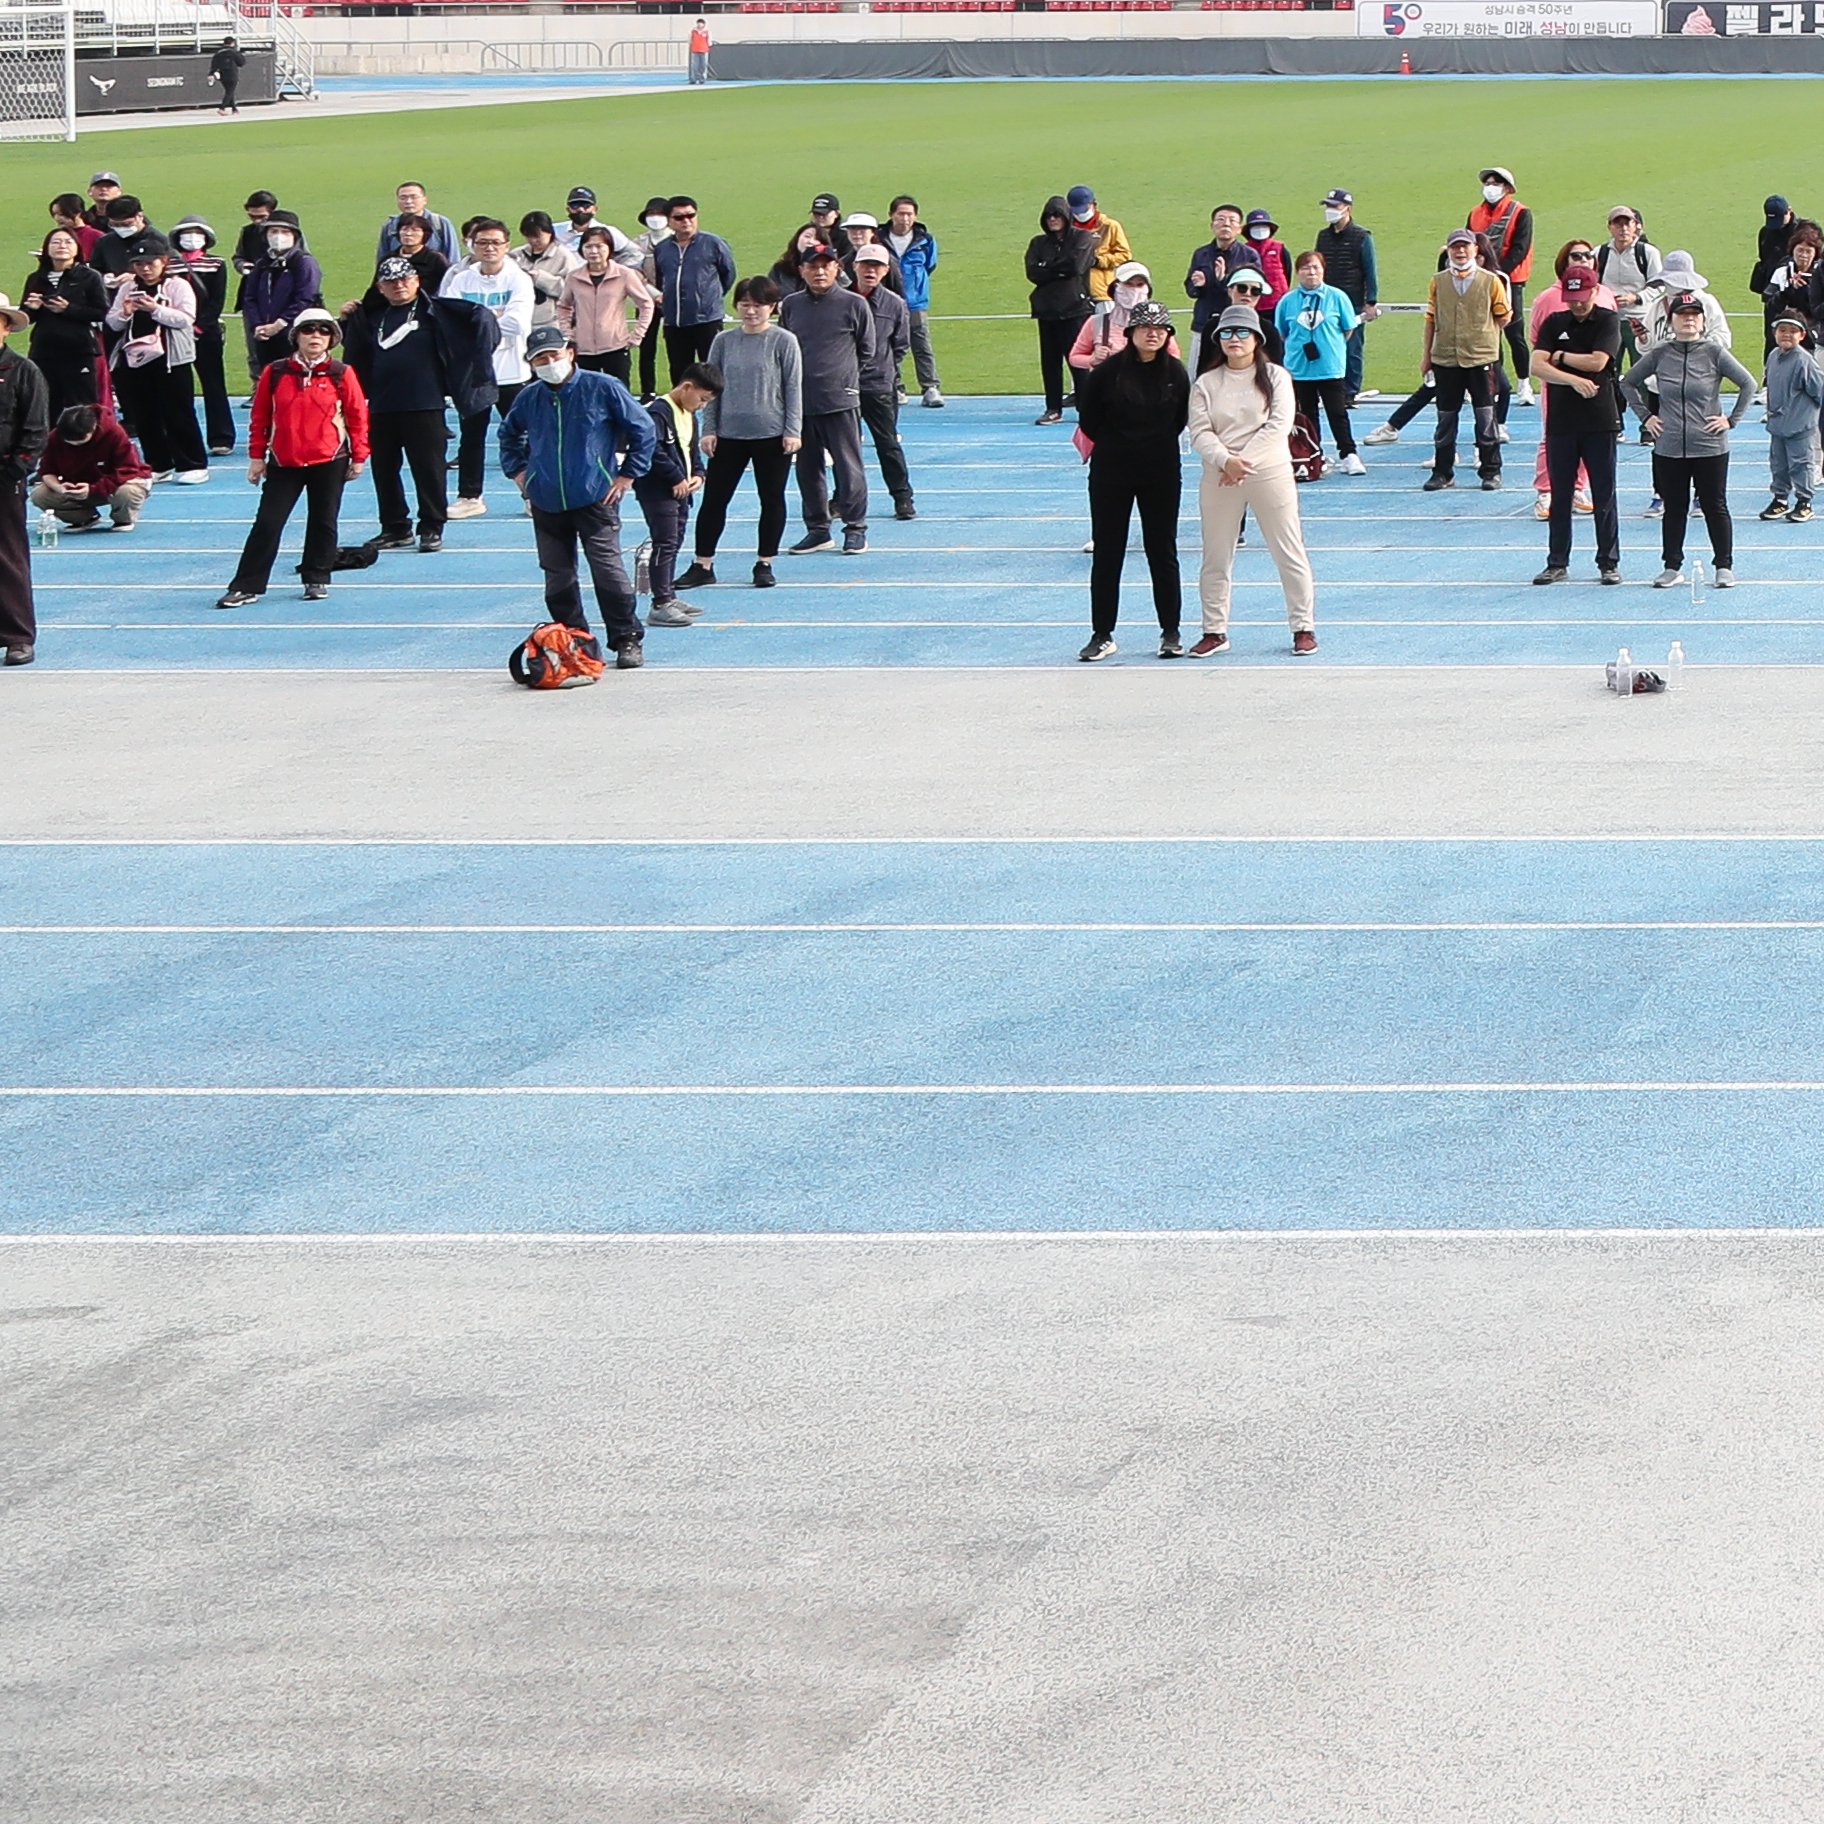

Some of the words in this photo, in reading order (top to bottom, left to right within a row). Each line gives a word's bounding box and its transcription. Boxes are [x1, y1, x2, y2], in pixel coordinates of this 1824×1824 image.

[1484, 5, 1515, 16] 성남시
[1538, 4, 1574, 16] 50주년
[1422, 21, 1459, 36] 우리가
[1463, 22, 1499, 36] 원하는
[1540, 21, 1580, 36] 성남이
